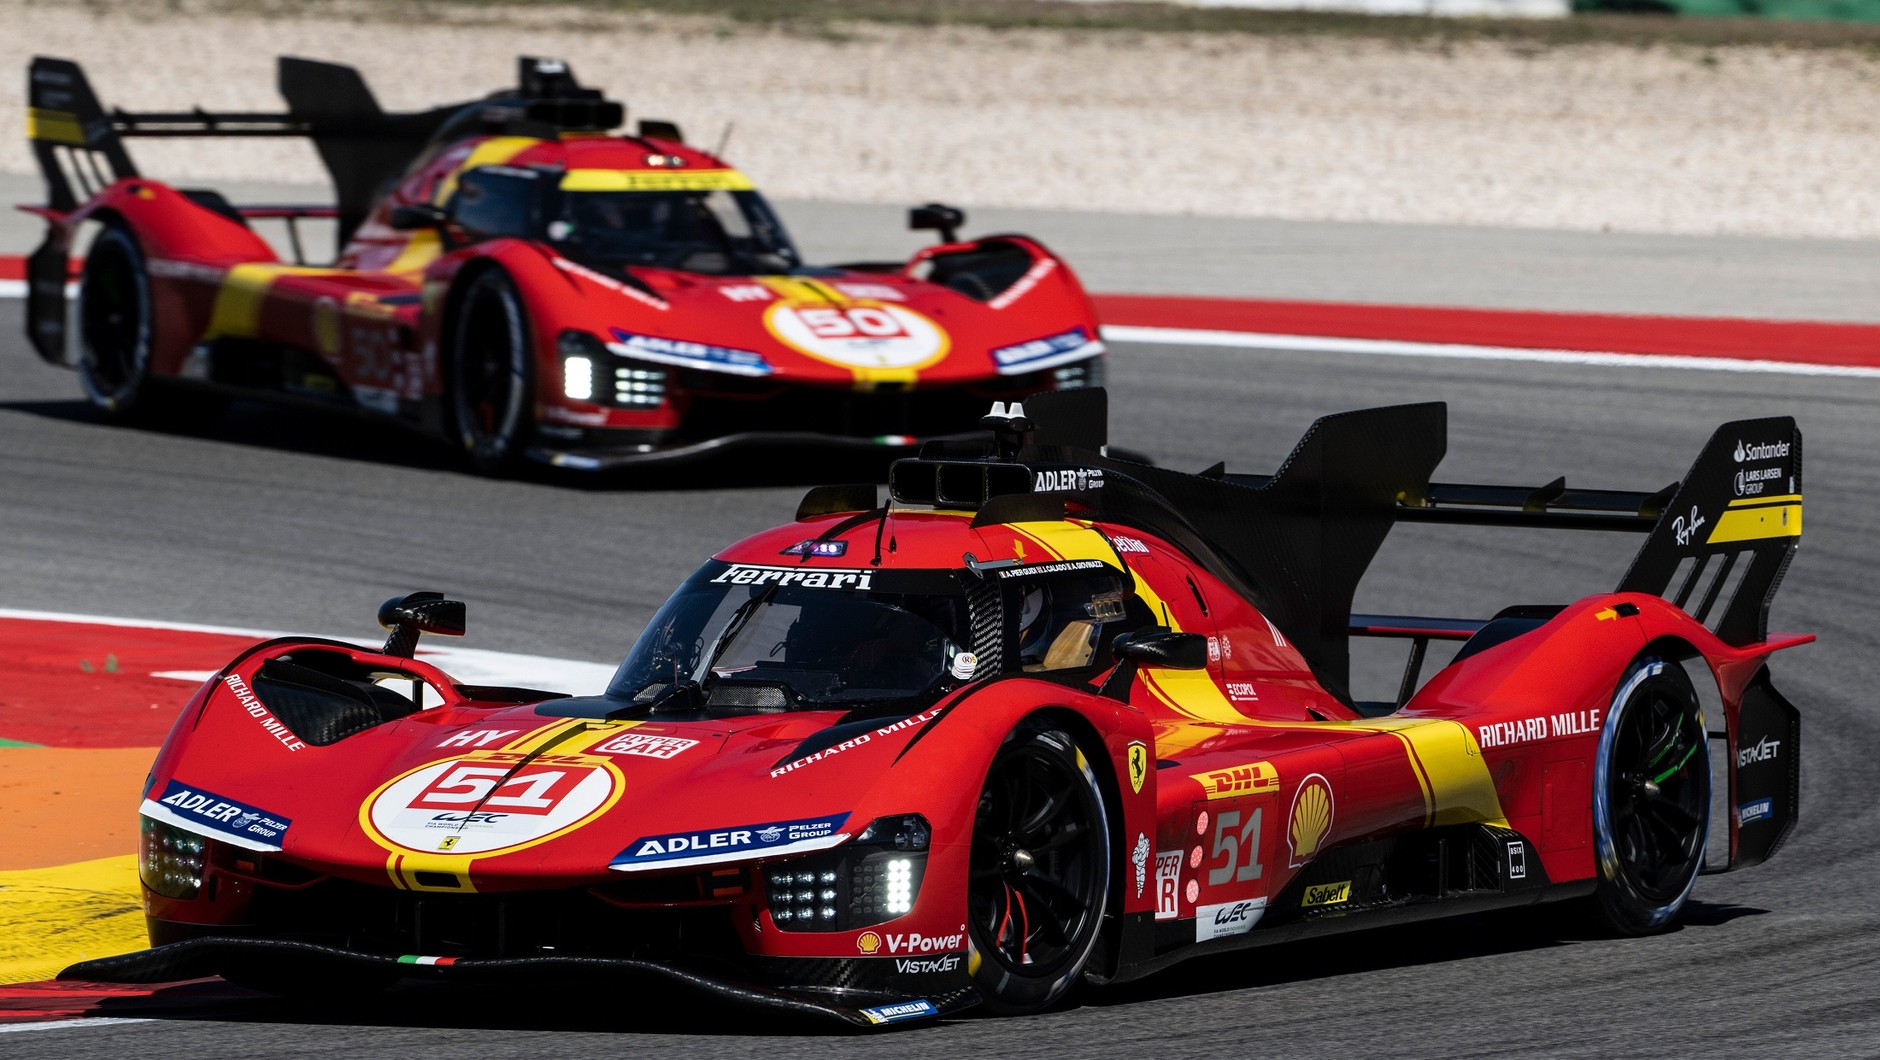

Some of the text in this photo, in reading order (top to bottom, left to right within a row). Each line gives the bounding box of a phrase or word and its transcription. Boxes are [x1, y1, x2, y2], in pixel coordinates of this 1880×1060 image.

[797, 309, 901, 336] 50
[1745, 440, 1791, 461] Santander
[1034, 470, 1076, 492] ADLER
[1745, 467, 1782, 482] LARS LARSEN
[1745, 482, 1764, 495] GROUP
[1671, 505, 1706, 546] Ray-Ban
[709, 564, 872, 591] Ferrari
[1232, 683, 1256, 696] ECOPOL
[224, 674, 306, 752] RICHARD MILLE
[1478, 708, 1600, 748] RICHARD MILLE
[435, 730, 521, 748] HY
[604, 741, 678, 757] CAR
[620, 734, 692, 747] HYPER
[769, 734, 871, 779] RICHARD
[422, 766, 567, 808] 51
[1208, 766, 1270, 793] DHL
[161, 790, 241, 822] ADLER
[258, 817, 288, 831] PELZER
[431, 812, 510, 824] WEC
[788, 822, 832, 832] PELZER
[247, 823, 277, 838] GROUP
[788, 829, 832, 840] GROUP
[635, 831, 751, 856] ADLER
[1208, 807, 1263, 886] 51
[1156, 855, 1180, 877] PER
[1307, 884, 1346, 904] Sabelt
[1215, 902, 1251, 925] WEC
[886, 933, 963, 953] V-Power
[880, 1002, 930, 1016] MICHELIN
